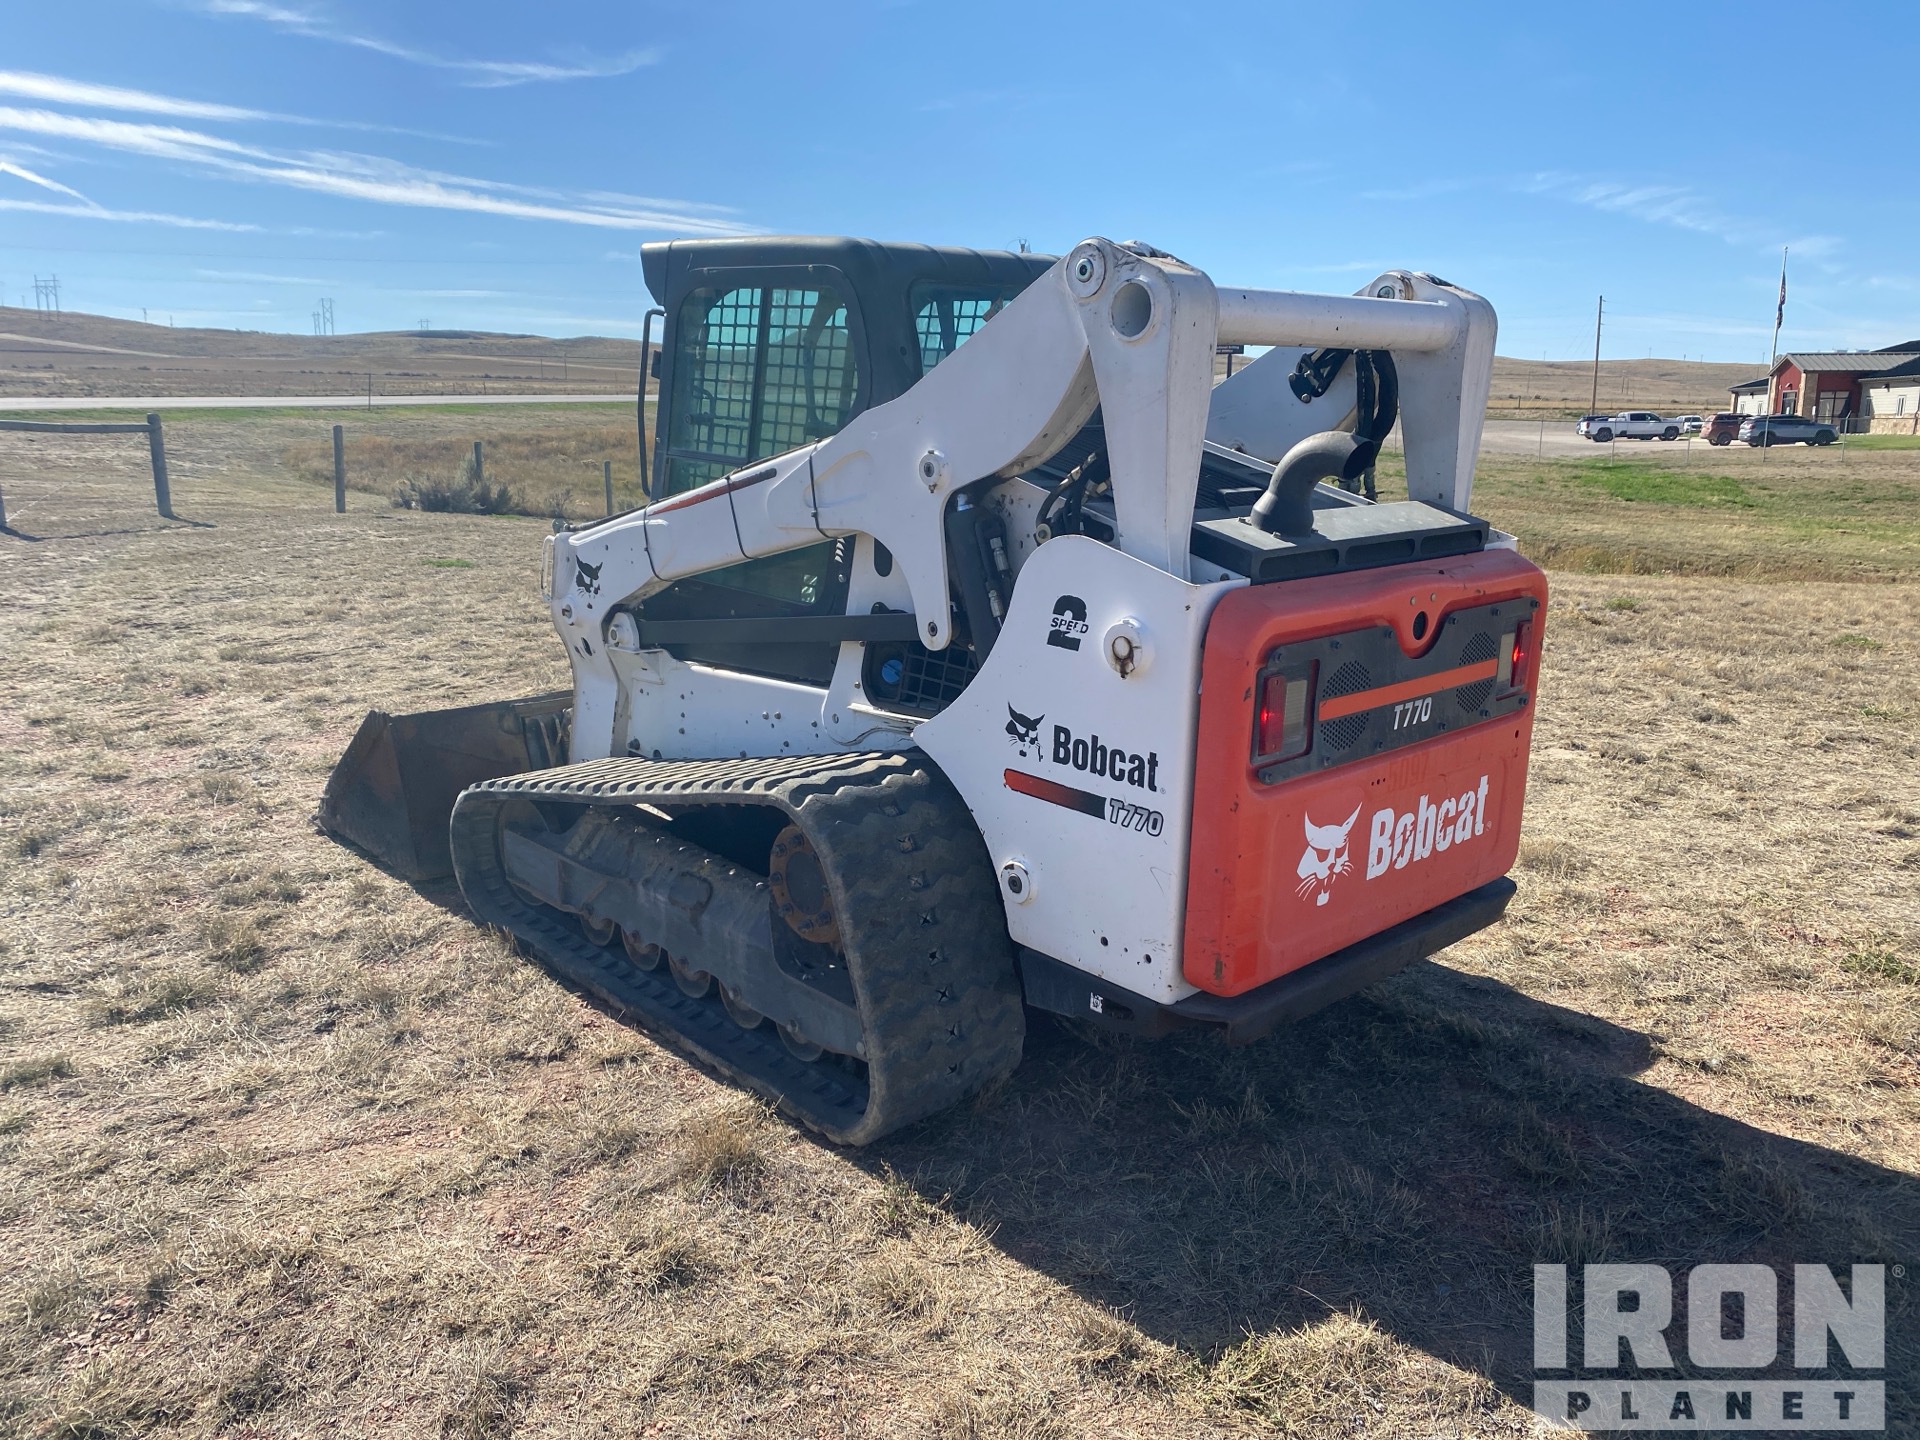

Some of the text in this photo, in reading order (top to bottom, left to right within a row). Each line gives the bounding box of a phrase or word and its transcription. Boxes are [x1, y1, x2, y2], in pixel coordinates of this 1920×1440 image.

[1393, 696, 1432, 731] T770
[1052, 724, 1159, 792] Bobcat
[1109, 797, 1164, 837] T770
[1366, 774, 1489, 881] Bobcat
